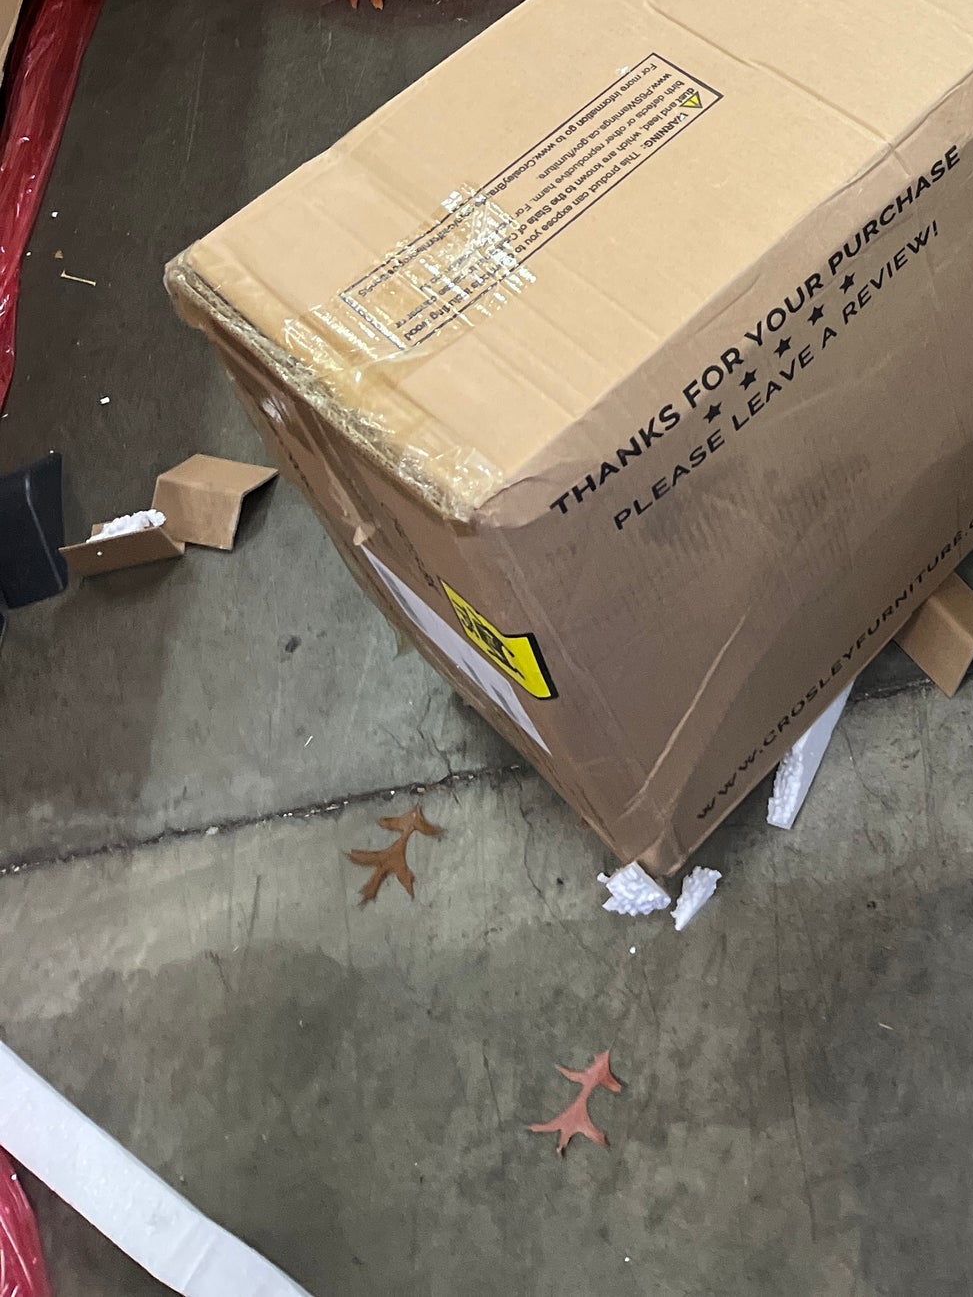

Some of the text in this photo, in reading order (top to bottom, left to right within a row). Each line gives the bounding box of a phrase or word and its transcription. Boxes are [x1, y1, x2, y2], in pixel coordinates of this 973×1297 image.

[663, 80, 685, 96] birth
[674, 87, 695, 103] dust
[555, 62, 657, 144] For more information go to
[635, 94, 665, 119] defects
[659, 101, 678, 116] and
[626, 117, 637, 127] or
[604, 125, 627, 144] other
[615, 131, 642, 152] which
[554, 142, 606, 184] reproductive
[601, 150, 618, 164] are
[619, 151, 641, 167] This
[573, 162, 604, 186] known
[587, 164, 622, 193] product
[564, 184, 577, 194] to
[549, 192, 567, 206] the
[571, 191, 590, 206] can
[514, 203, 532, 218] For
[526, 204, 552, 225] State
[540, 204, 573, 231] expose
[517, 223, 528, 234] of
[523, 229, 543, 246] you
[514, 244, 527, 254] to
[549, 145, 961, 515] THANKS FOR YOUR PURCHASE
[613, 219, 939, 531] PLEASE LEAVE A REVIEW!
